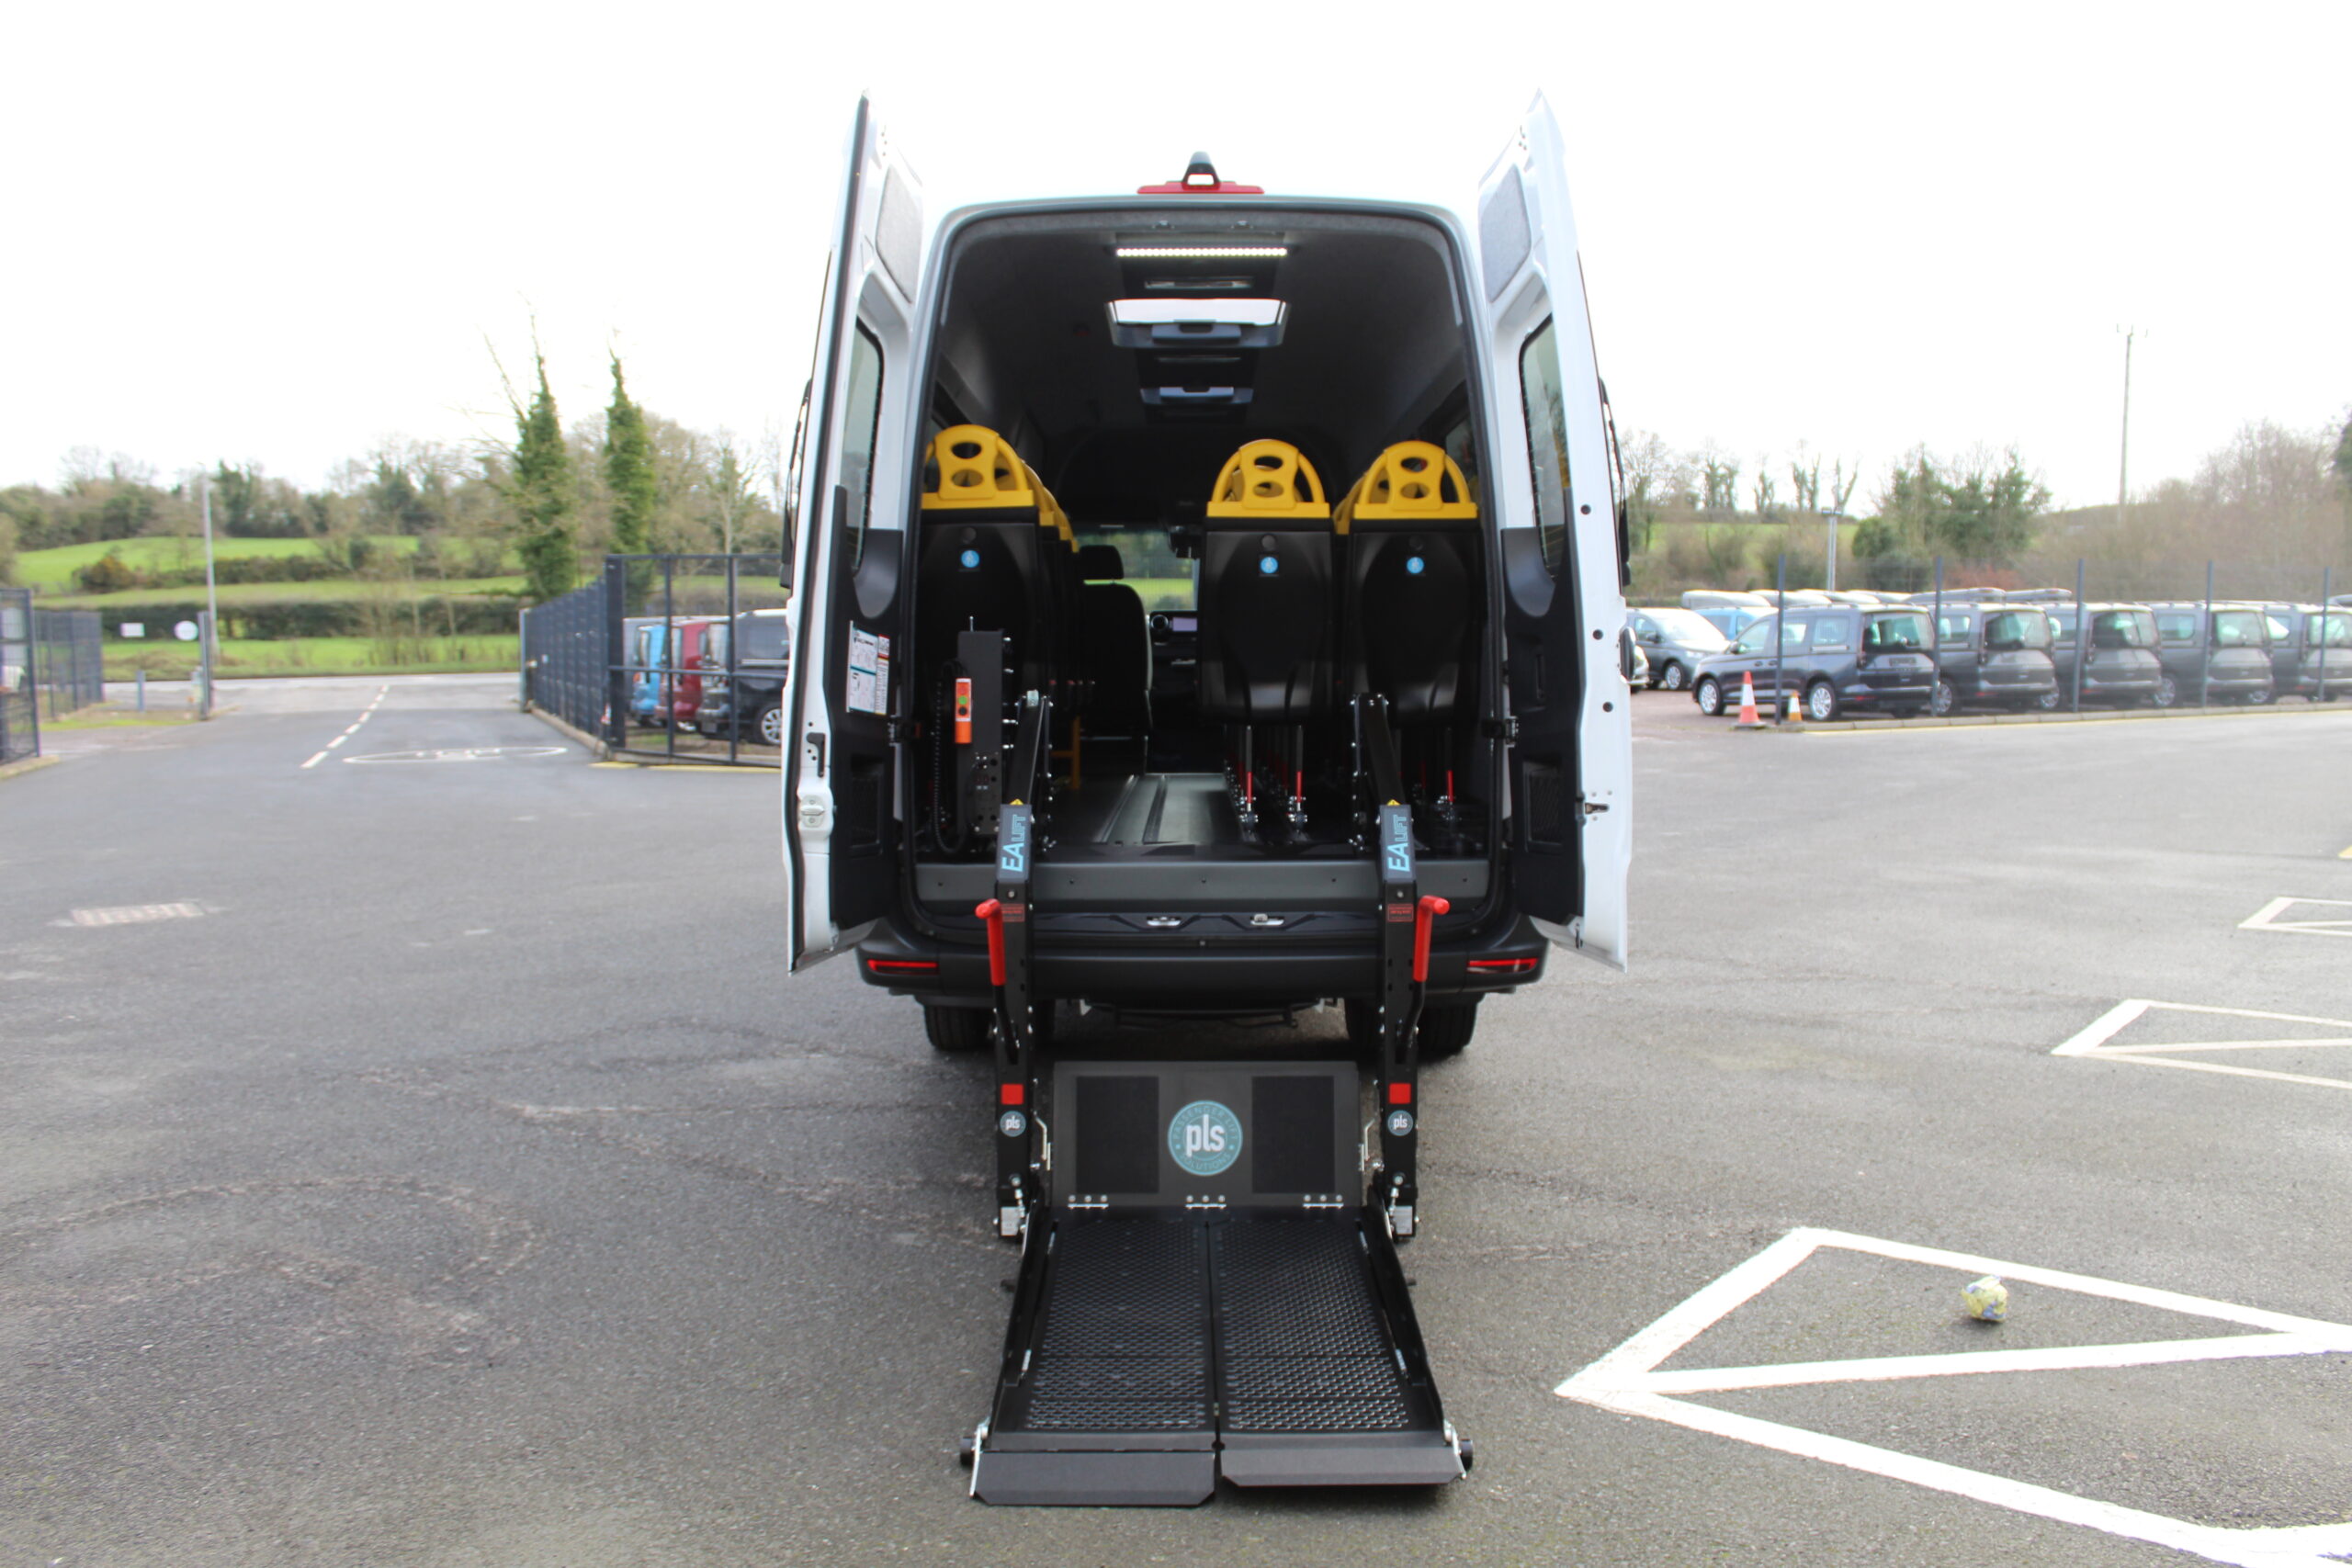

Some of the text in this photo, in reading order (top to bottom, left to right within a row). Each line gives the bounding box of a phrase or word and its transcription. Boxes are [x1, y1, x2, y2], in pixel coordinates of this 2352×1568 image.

[1005, 1115, 1021, 1131] pls
[1393, 1114, 1408, 1130] pls
[1186, 1114, 1226, 1157] pls
[1179, 1151, 1230, 1170] SOLUTIONS
